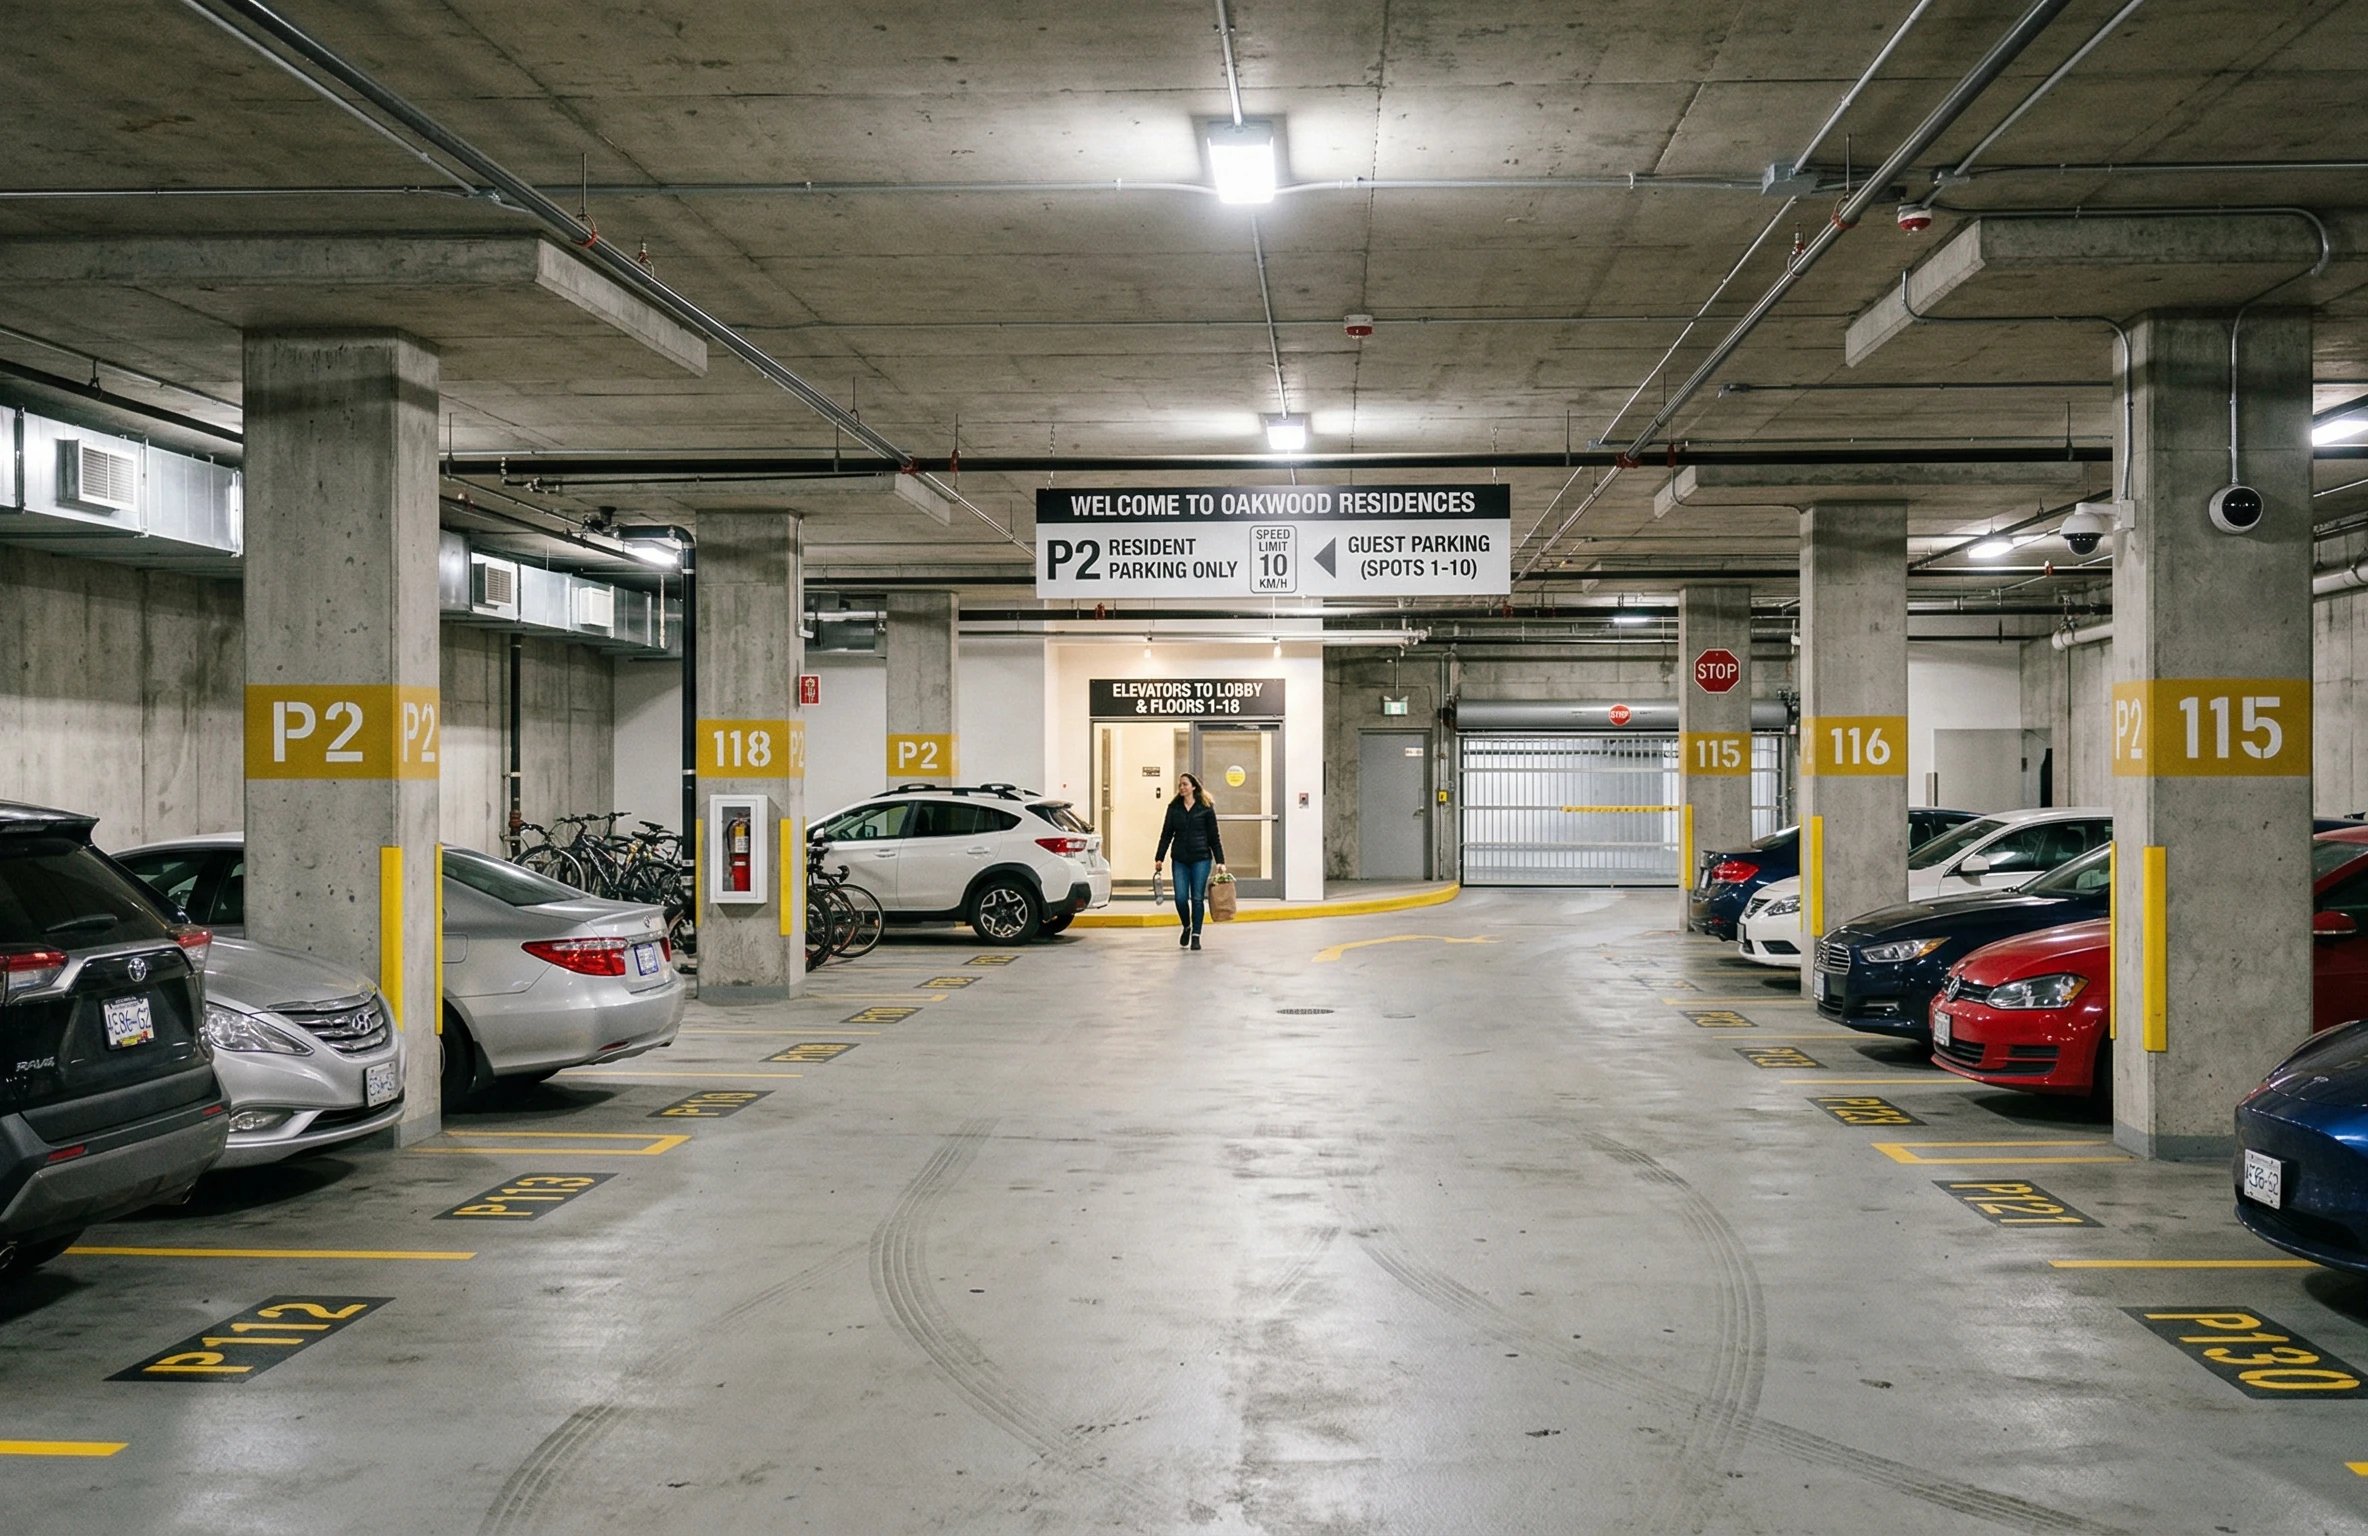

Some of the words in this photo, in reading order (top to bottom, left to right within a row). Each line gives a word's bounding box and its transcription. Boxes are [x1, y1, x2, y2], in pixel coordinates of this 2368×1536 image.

[1070, 494, 1181, 517] WELCOME
[1186, 494, 1215, 516] TO
[1221, 493, 1332, 515] OAKWOOD
[1339, 491, 1476, 514] RESIDENCES
[1109, 538, 1196, 556] RESIDENT
[1256, 529, 1291, 540] SPEED
[1258, 541, 1288, 552] LIMIT
[1348, 536, 1406, 553] GUEST
[1411, 534, 1491, 553] PARKING
[1047, 539, 1101, 580] P2
[1109, 561, 1187, 579] PARKING
[1193, 560, 1238, 578] ONLY
[1259, 553, 1288, 577] 10
[1360, 558, 1425, 580] (SPOTS
[1431, 558, 1477, 580] 1-10)
[1259, 578, 1288, 590] KM/H
[1697, 662, 1738, 680] STOP
[1112, 682, 1192, 698] ELEVATORS
[1194, 682, 1213, 698] TO
[1216, 682, 1264, 698] LOBBY
[1135, 699, 1148, 714] &
[1150, 699, 1205, 714] FLOORS
[1207, 699, 1241, 714] 1-18
[273, 701, 364, 763] P2
[403, 701, 436, 763] P2
[2115, 697, 2143, 760] P2
[2179, 696, 2283, 759] 115
[713, 730, 772, 767] 118
[898, 741, 939, 769] P2
[1696, 739, 1742, 768] 115
[1830, 727, 1891, 766] 116
[452, 1175, 596, 1216] P113
[1949, 1183, 2085, 1224] P121
[141, 1302, 368, 1374] P112
[2142, 1312, 2362, 1391] P130
